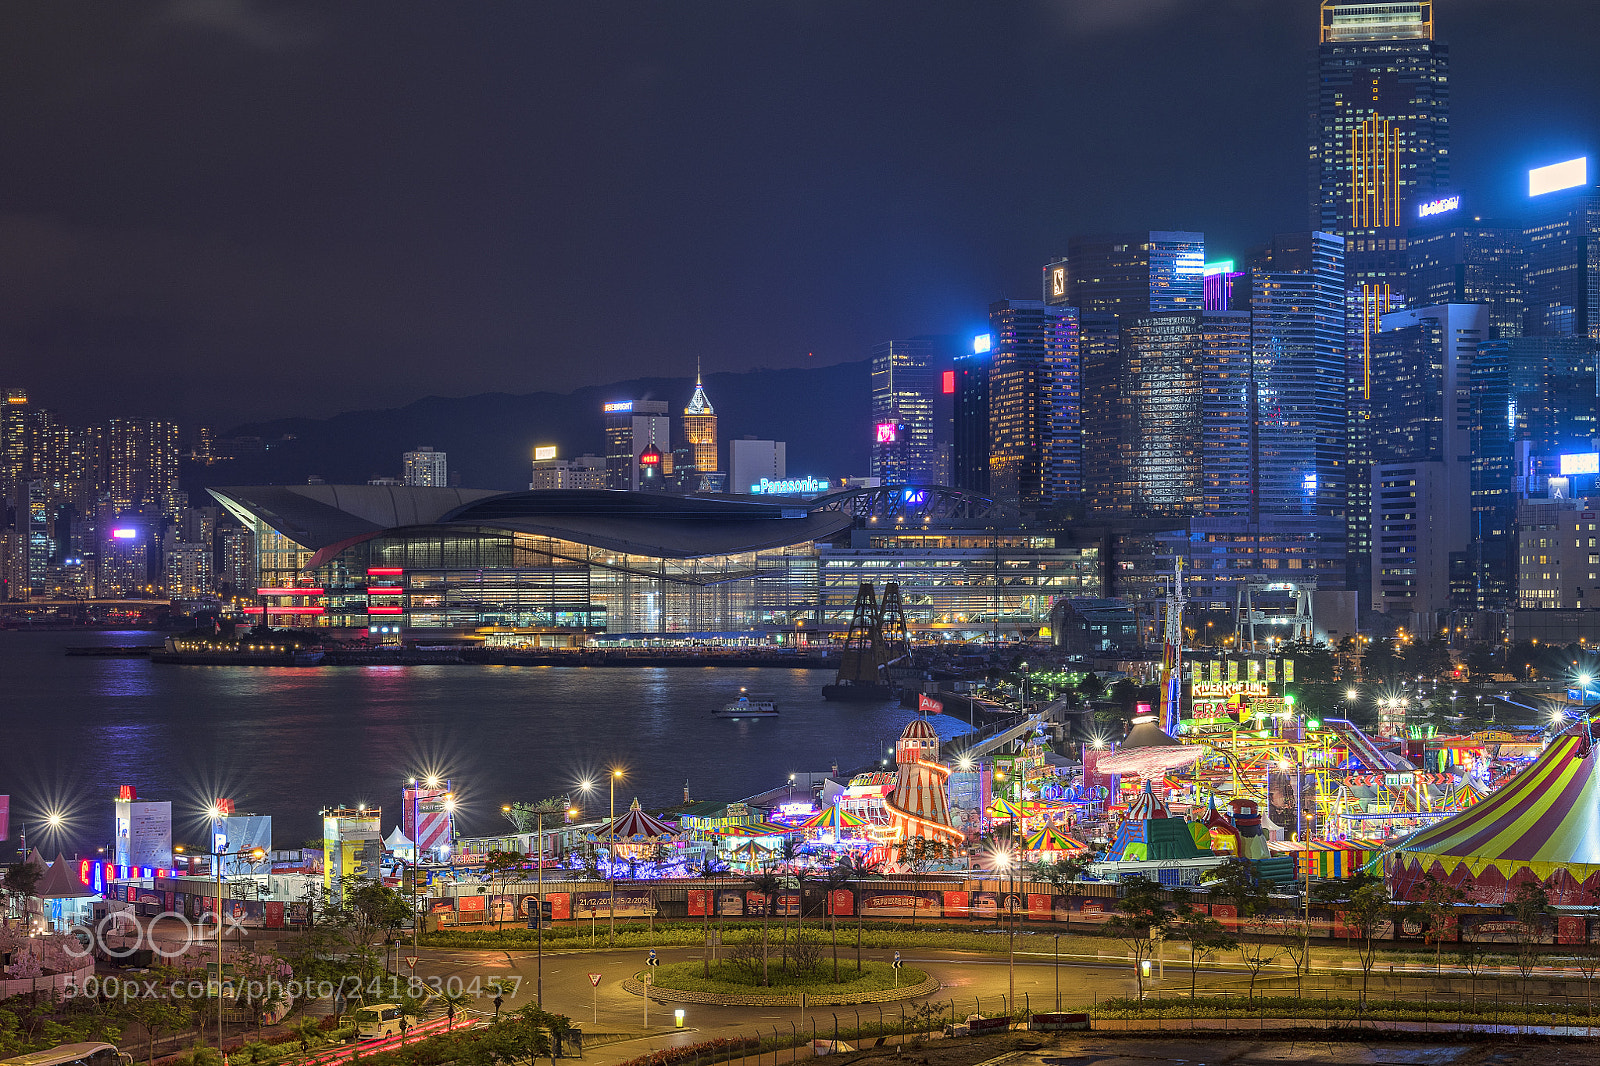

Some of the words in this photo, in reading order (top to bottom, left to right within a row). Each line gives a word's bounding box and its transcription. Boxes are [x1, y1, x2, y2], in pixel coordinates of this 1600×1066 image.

[760, 476, 819, 494] Panasonic
[1193, 681, 1223, 696] RIVER
[1222, 680, 1268, 696] RAFTING
[1193, 703, 1246, 713] CRASH
[1247, 702, 1286, 713] TEST
[1473, 732, 1488, 740] TOP
[1488, 732, 1513, 740] GEAR
